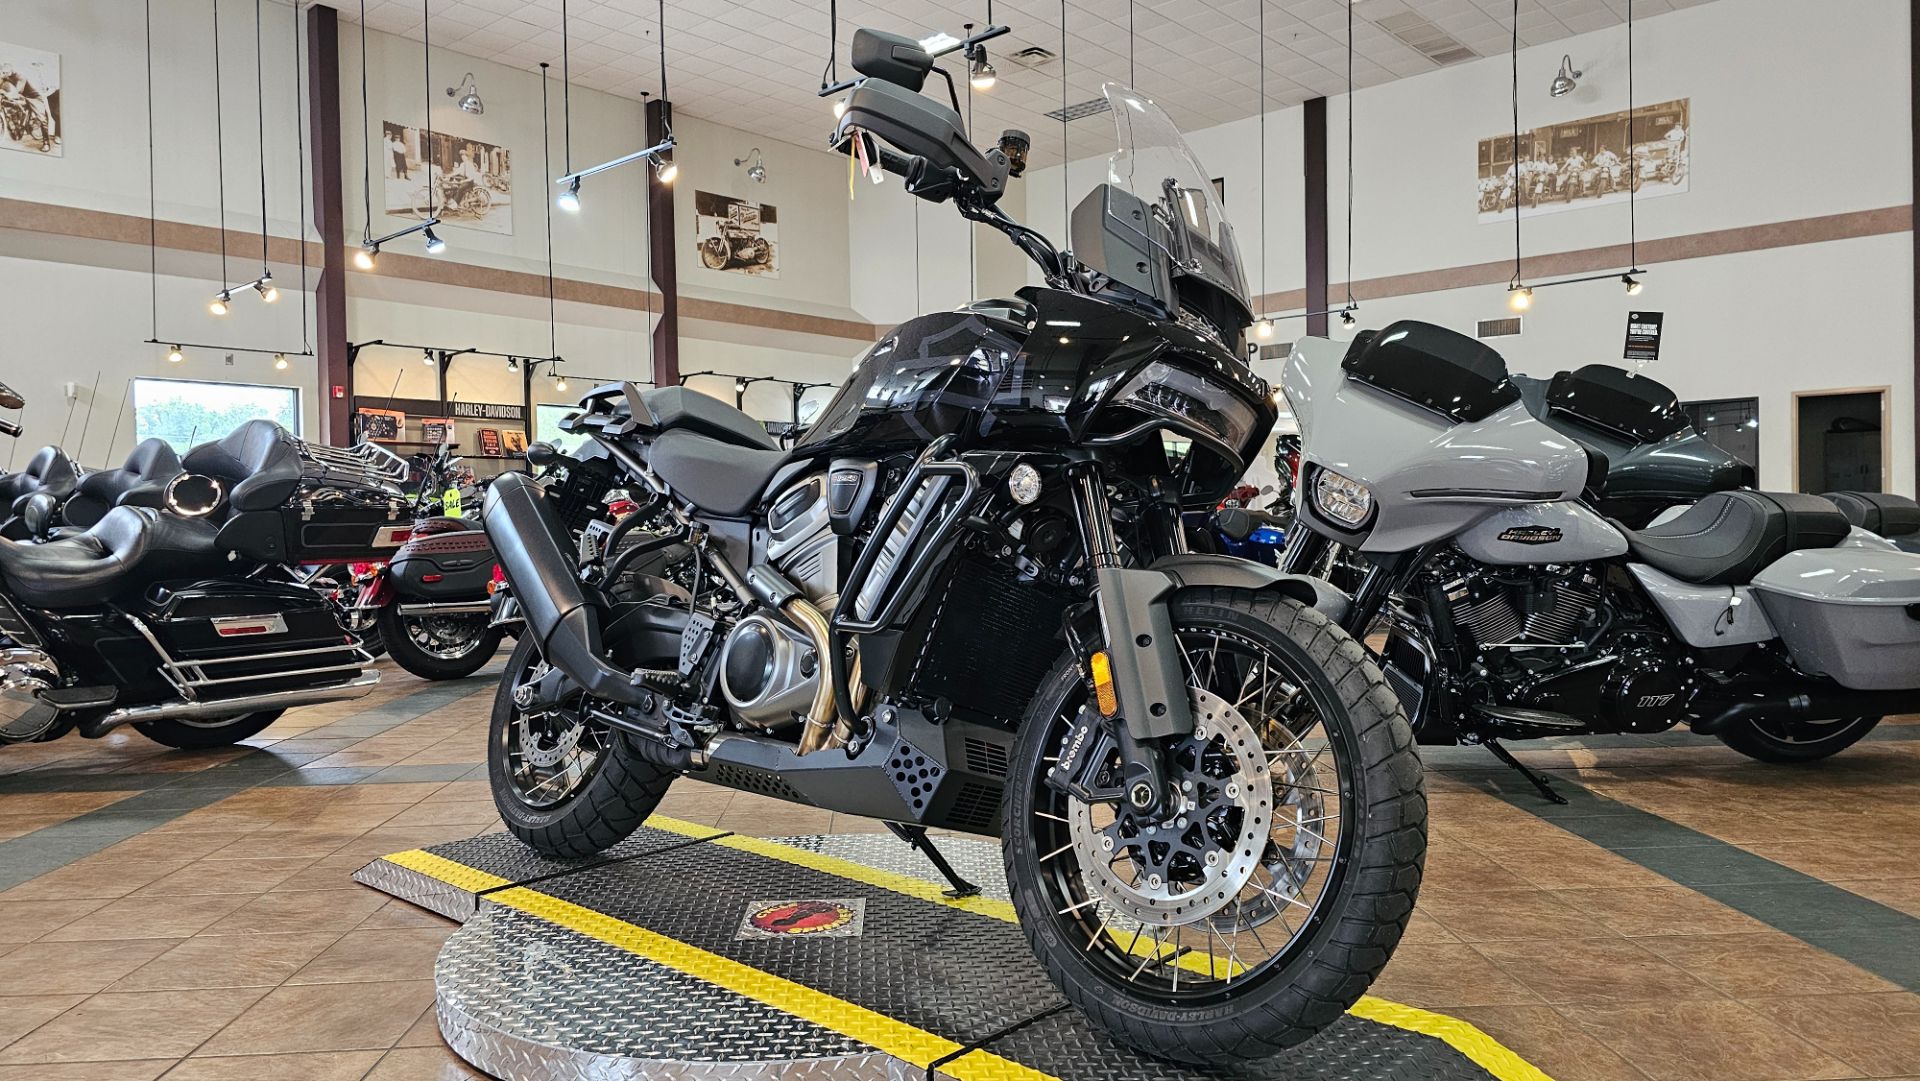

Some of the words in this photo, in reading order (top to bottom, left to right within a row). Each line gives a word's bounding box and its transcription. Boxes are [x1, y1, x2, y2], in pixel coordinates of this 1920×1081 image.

[455, 402, 521, 419] HARLEY-DAVIDSON
[445, 498, 460, 510] SALE
[1636, 693, 1676, 707] 117
[1060, 725, 1088, 770] brembo
[1012, 782, 1025, 855] SCORCHER
